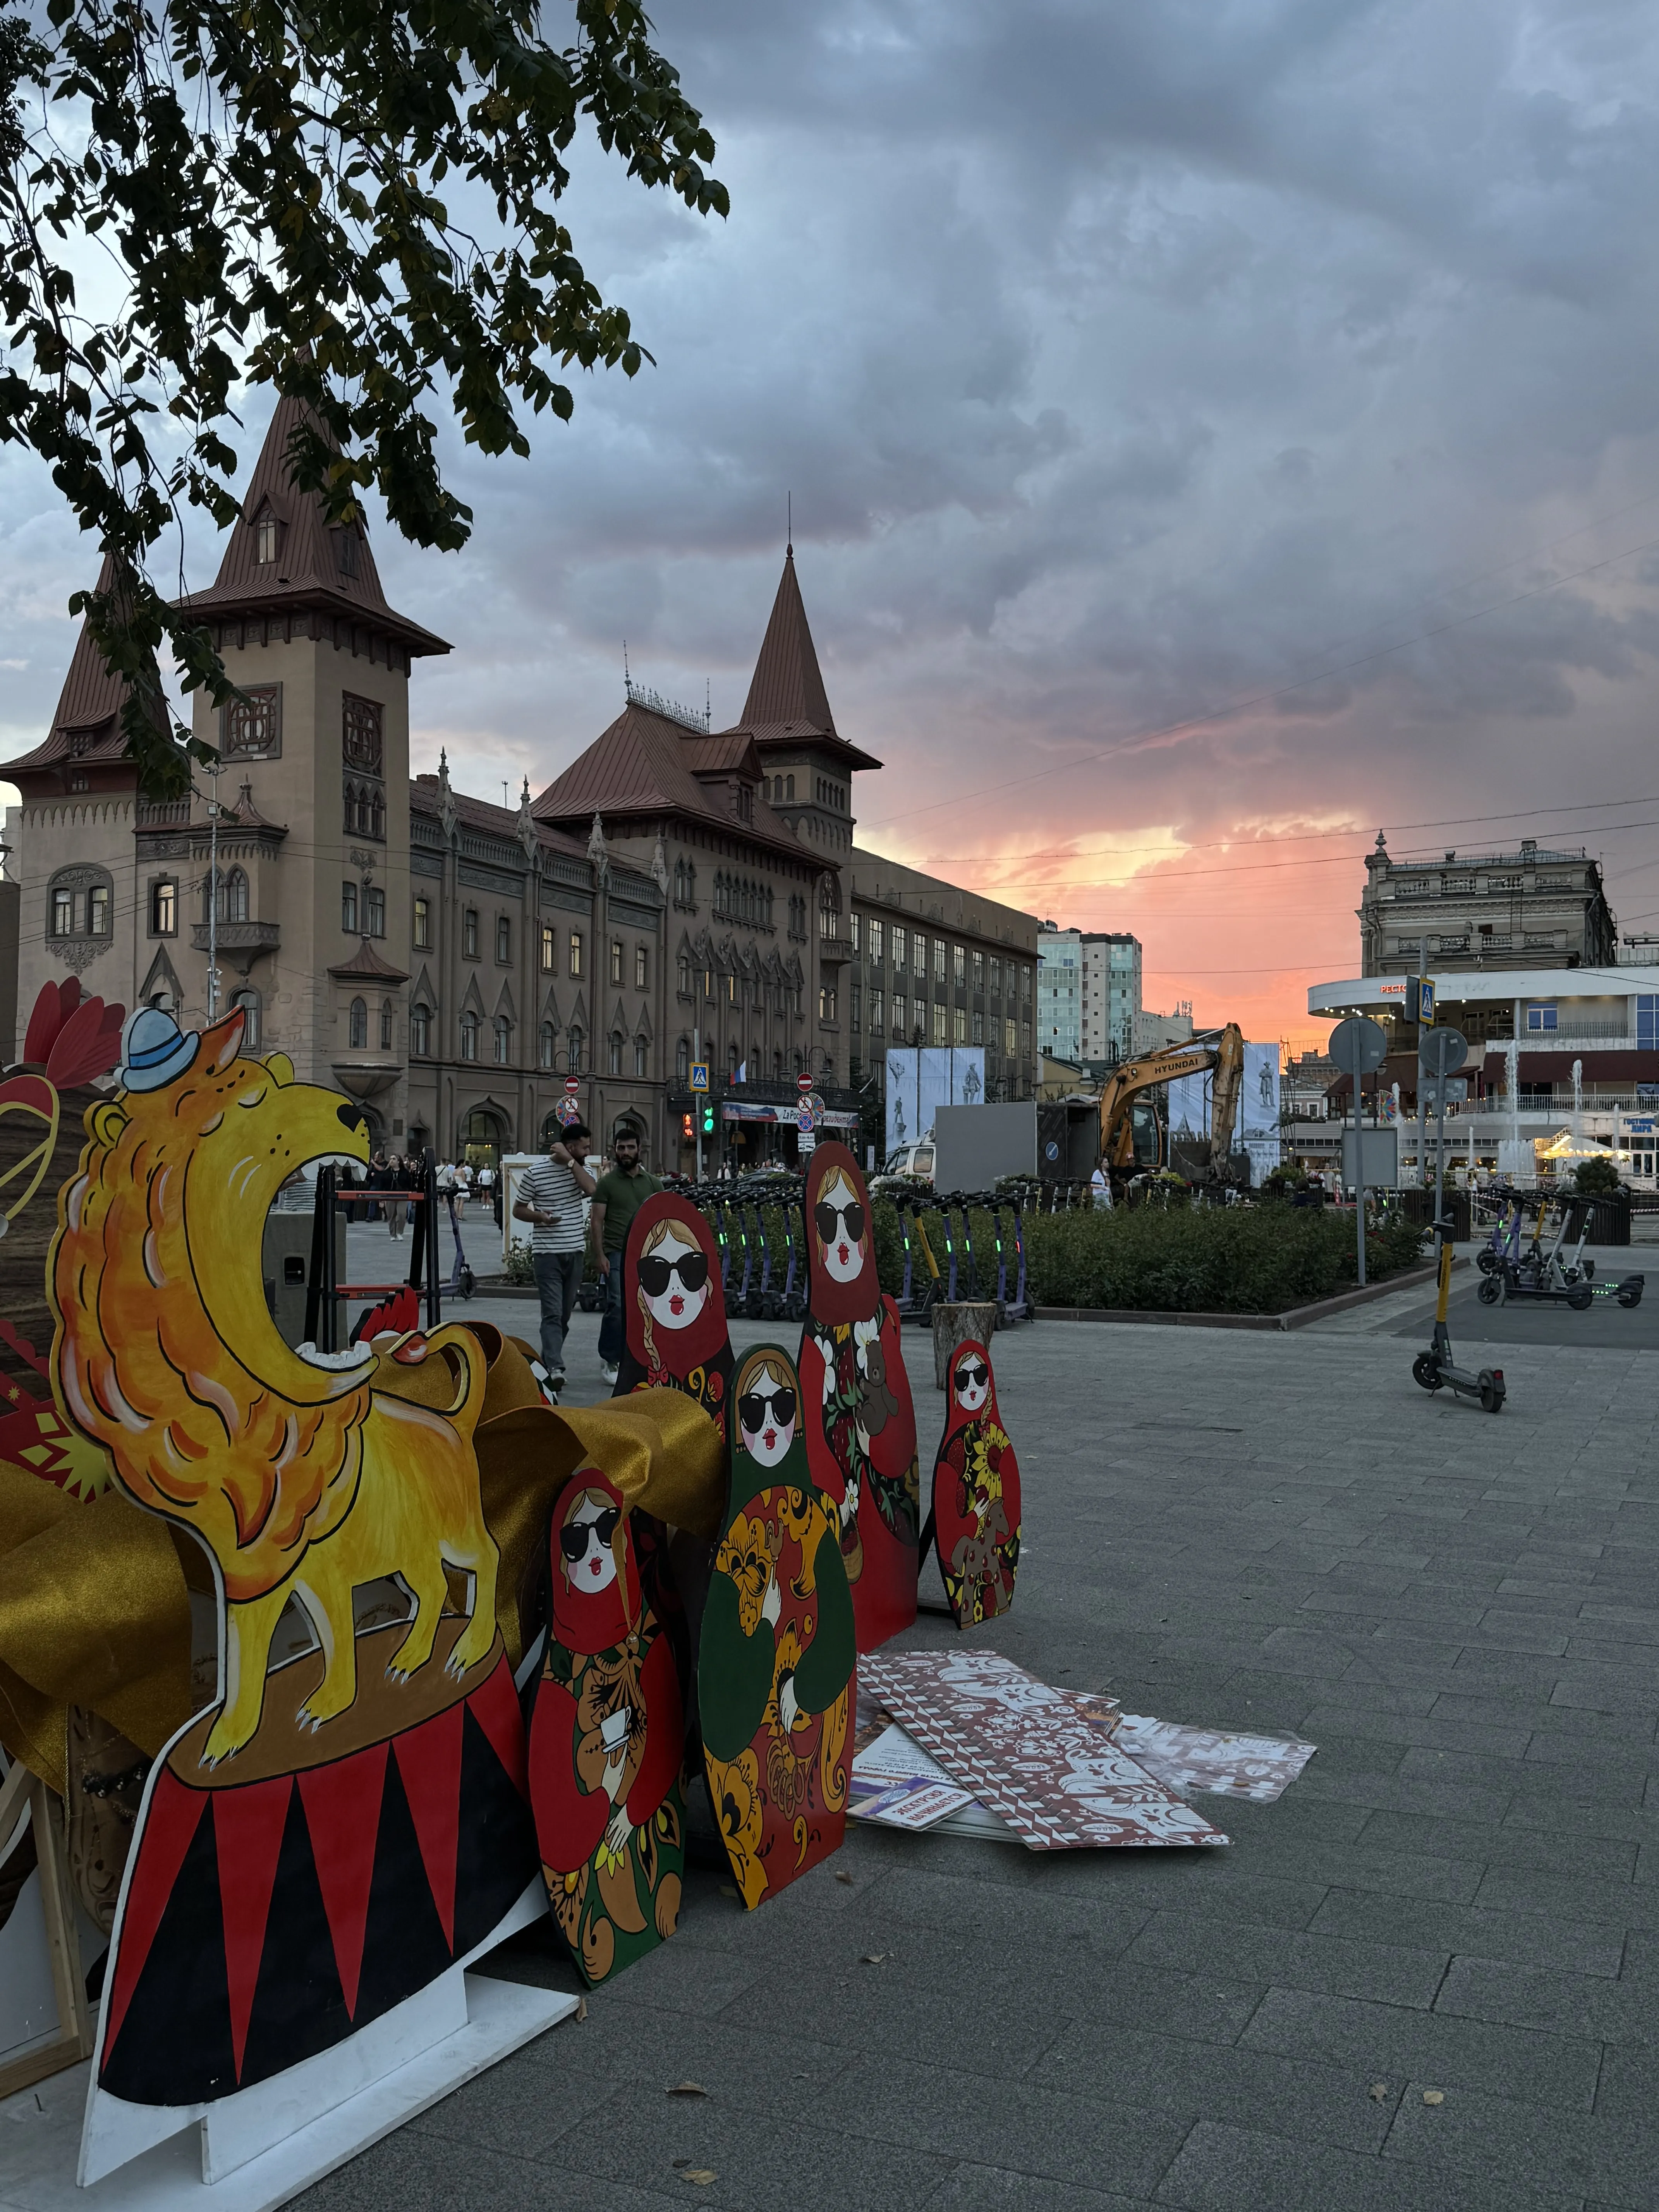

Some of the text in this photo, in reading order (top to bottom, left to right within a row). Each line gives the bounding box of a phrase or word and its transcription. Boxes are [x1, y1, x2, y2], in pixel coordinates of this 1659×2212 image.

[1381, 984, 1407, 993] РЕСТО
[1155, 1058, 1198, 1074] HYUNDAI
[892, 1790, 946, 1815] ЭКСКУРСИЯ
[907, 1793, 967, 1821] НАЧИНАЕТСЯ
